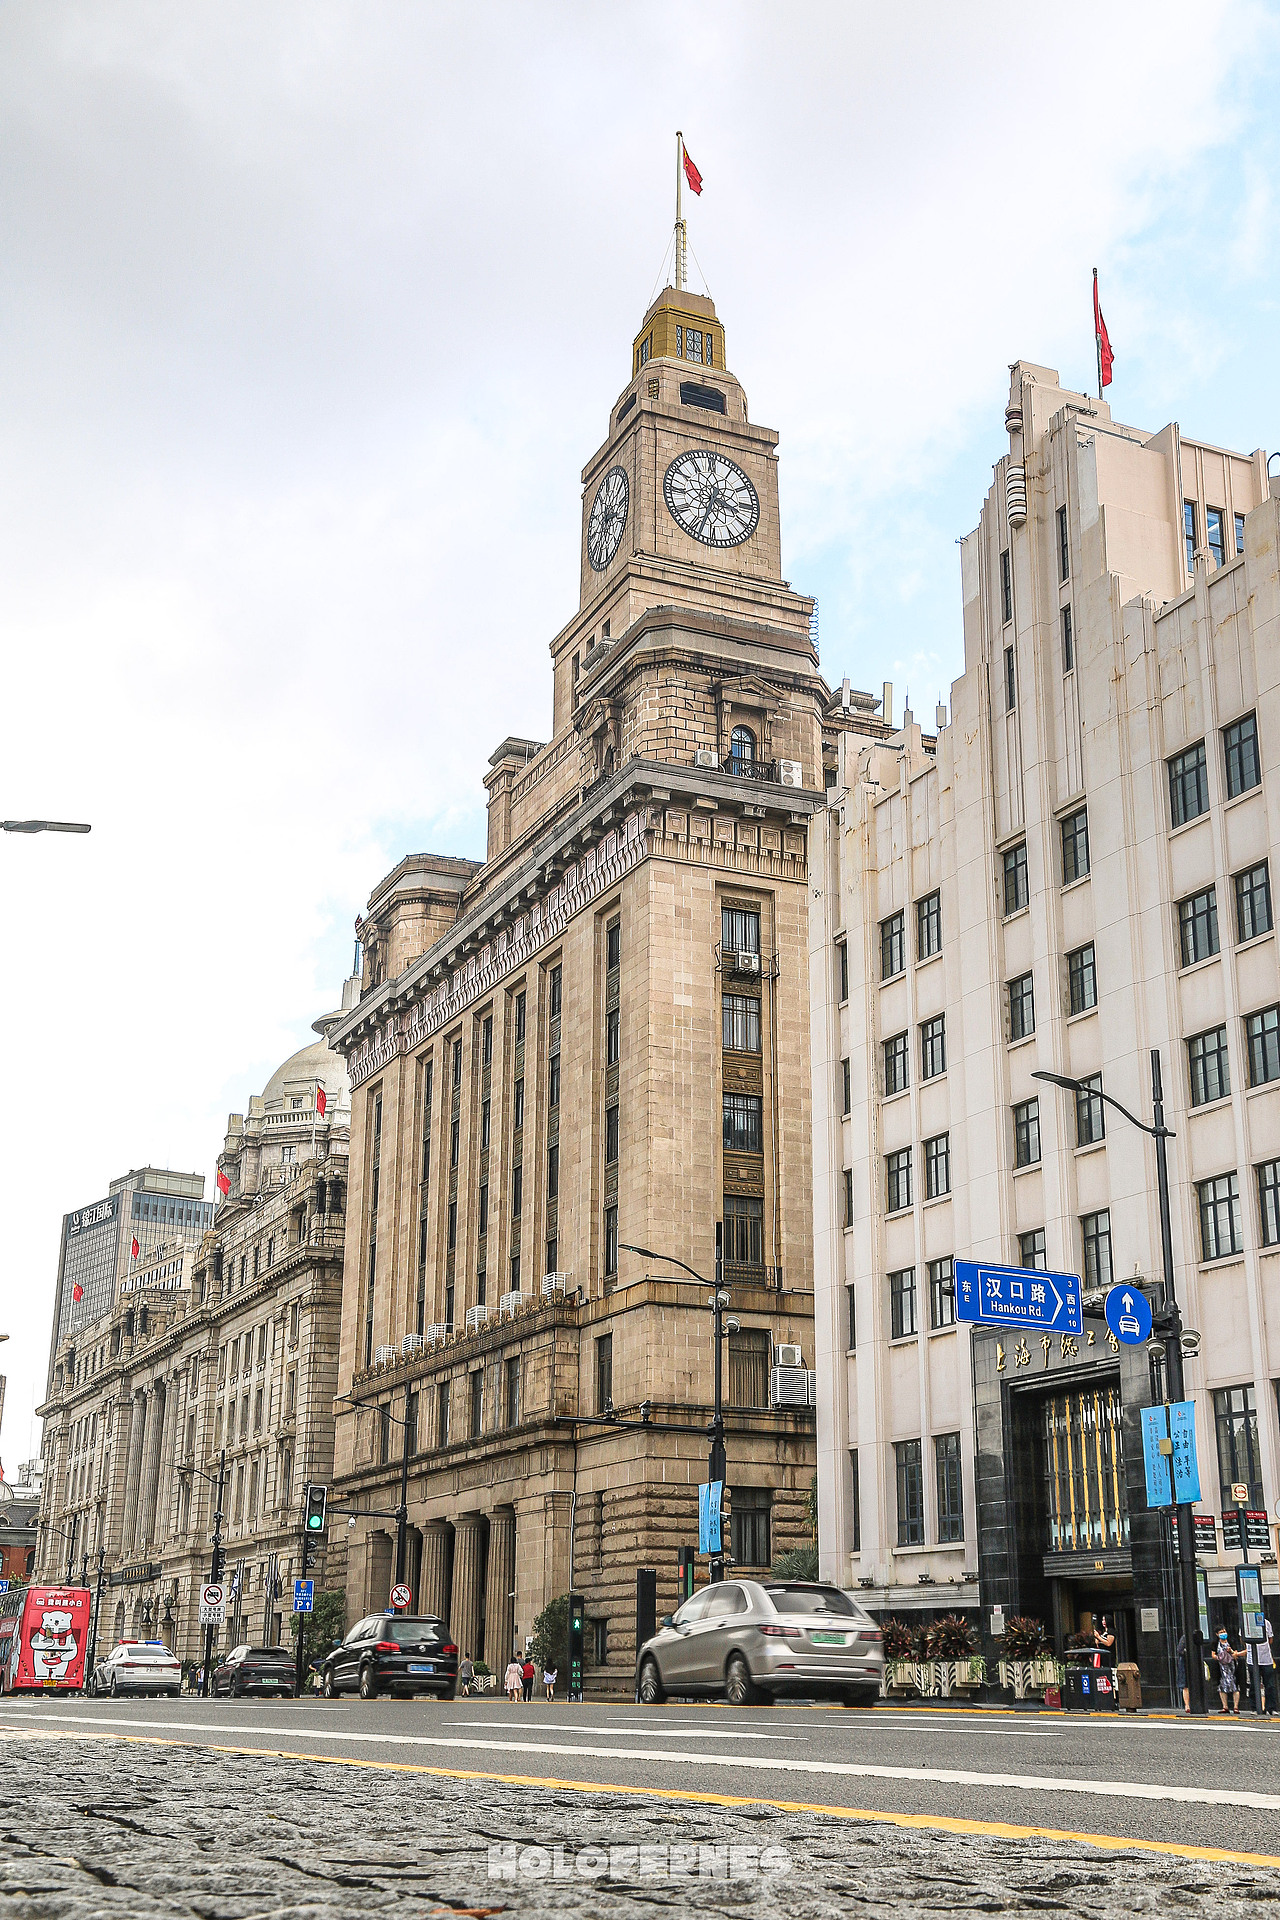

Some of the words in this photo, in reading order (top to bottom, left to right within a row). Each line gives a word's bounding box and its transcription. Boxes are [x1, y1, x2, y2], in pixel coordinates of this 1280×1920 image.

[961, 1280, 972, 1293] 东
[1067, 1280, 1073, 1288] 3
[986, 1278, 1046, 1304] 汉口路
[1066, 1293, 1076, 1305] 西
[991, 1300, 1027, 1315] Hankou
[1028, 1305, 1045, 1317] Rd.
[296, 1600, 303, 1610] P
